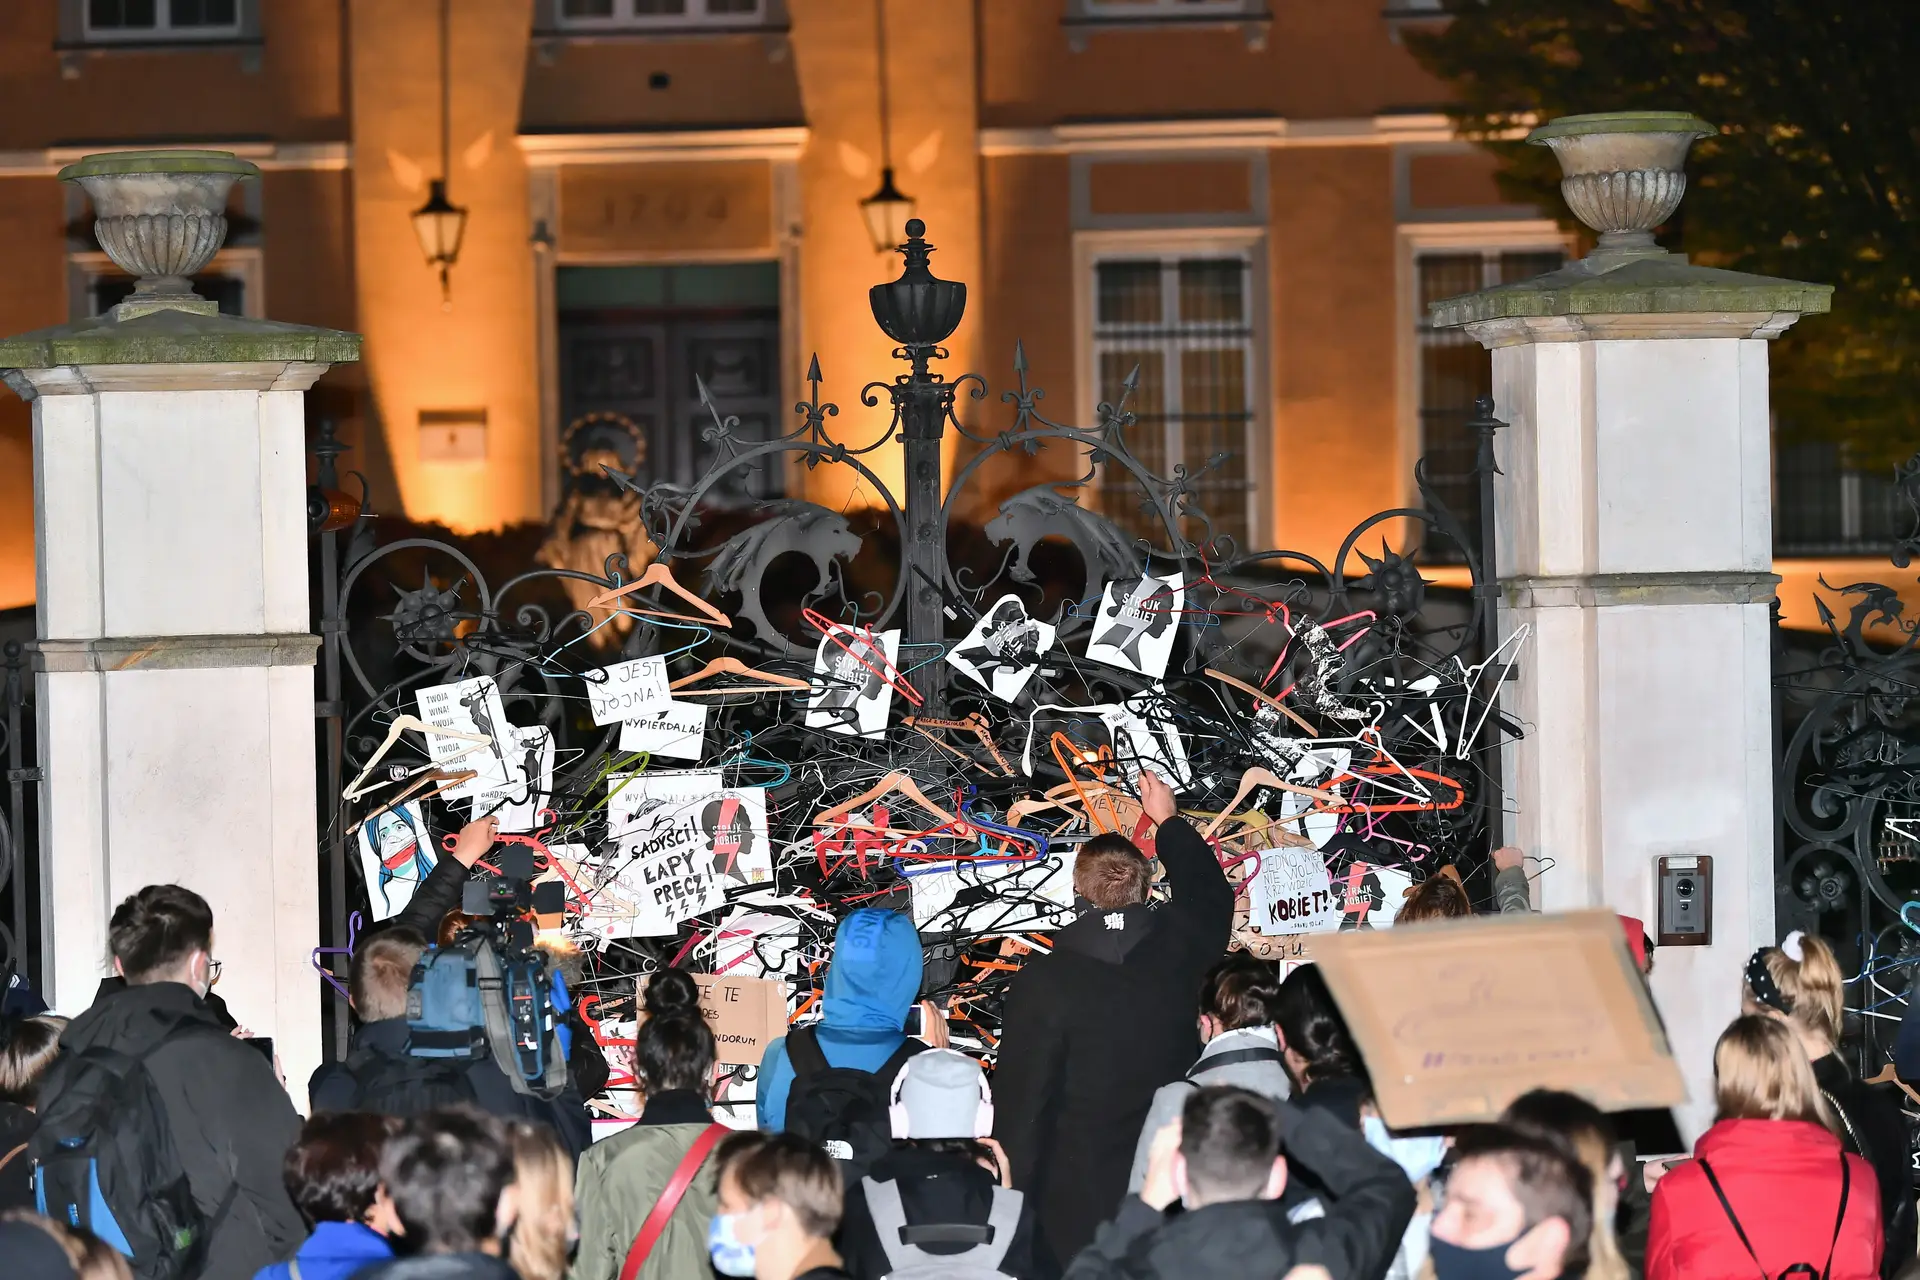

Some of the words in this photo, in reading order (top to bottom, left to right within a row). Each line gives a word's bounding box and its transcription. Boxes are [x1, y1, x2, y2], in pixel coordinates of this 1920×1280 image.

[1122, 592, 1161, 611] STRAJK
[1120, 604, 1157, 624] KOBIET
[990, 630, 1017, 658] KOBT
[619, 661, 662, 683] JEST
[834, 655, 874, 673] STRAJK
[425, 692, 449, 704] TWOJA
[592, 680, 664, 718] WOJNA!
[428, 706, 450, 717] WINA!
[624, 717, 703, 735] WYPIERDALAĆ
[437, 743, 461, 754] TWOJA
[712, 823, 742, 836] STRAJK
[714, 834, 742, 846] KOBIET
[643, 848, 696, 885] ŁAPY
[1262, 853, 1298, 874] JEDNO
[1301, 851, 1324, 863] WIEM
[1263, 871, 1280, 886] NIE
[1284, 861, 1325, 880] WOLNO
[653, 863, 715, 905] PRECZ!
[1342, 884, 1373, 897] STRAJK
[1344, 893, 1372, 906] KOBIET
[724, 986, 741, 1002] TE
[702, 1007, 720, 1019] DES
[713, 1033, 757, 1046] NDORUM
[718, 1063, 737, 1075] BIET
